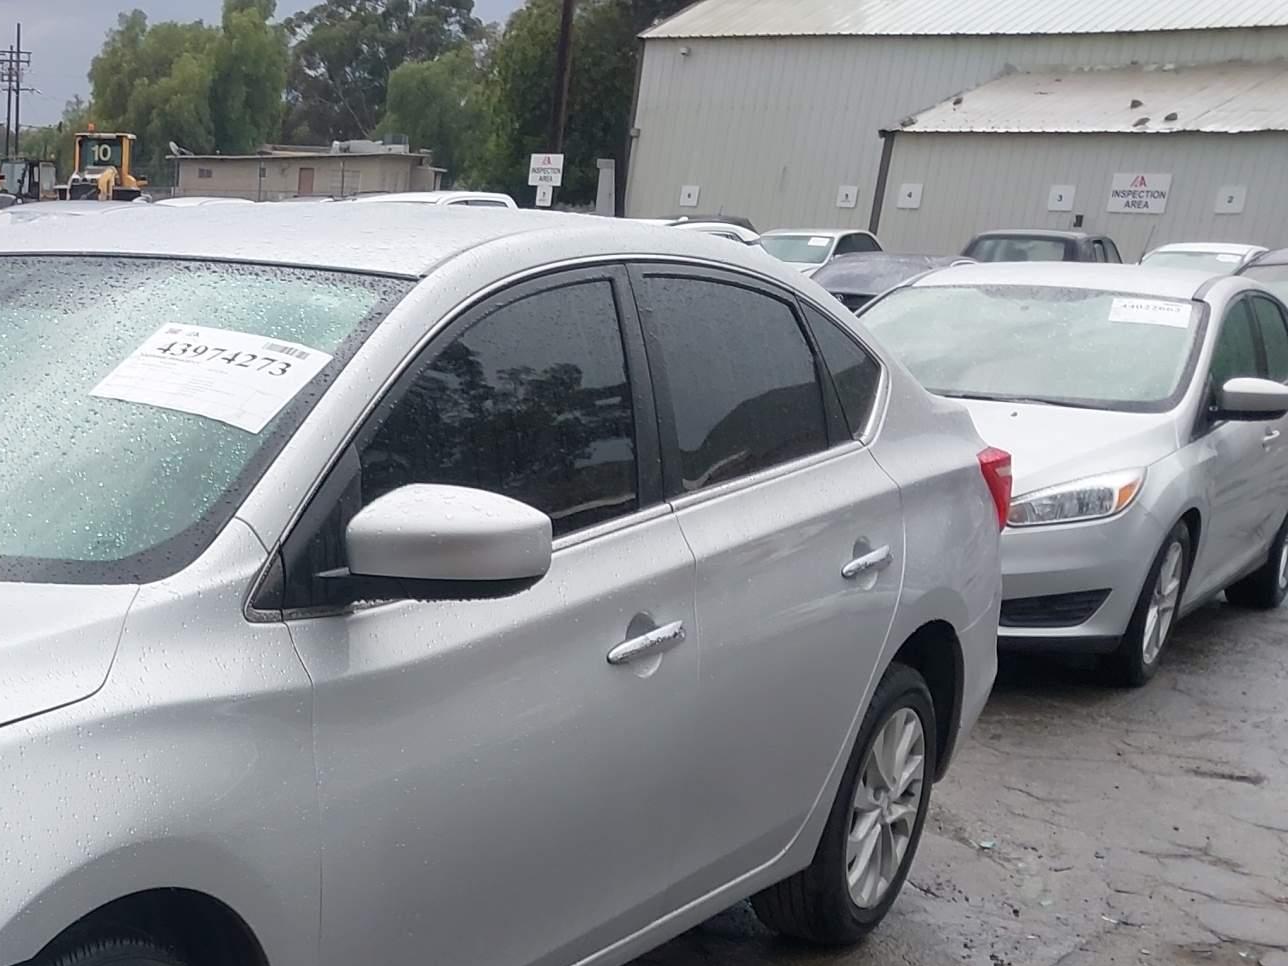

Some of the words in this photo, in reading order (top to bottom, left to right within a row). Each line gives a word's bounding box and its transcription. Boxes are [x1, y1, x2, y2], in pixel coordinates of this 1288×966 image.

[91, 144, 112, 161] 10
[1056, 194, 1063, 202] 3
[1111, 189, 1166, 200] INSPECTION
[1226, 195, 1235, 204] 2
[1123, 200, 1150, 209] AREA
[157, 341, 293, 377] 43974273
